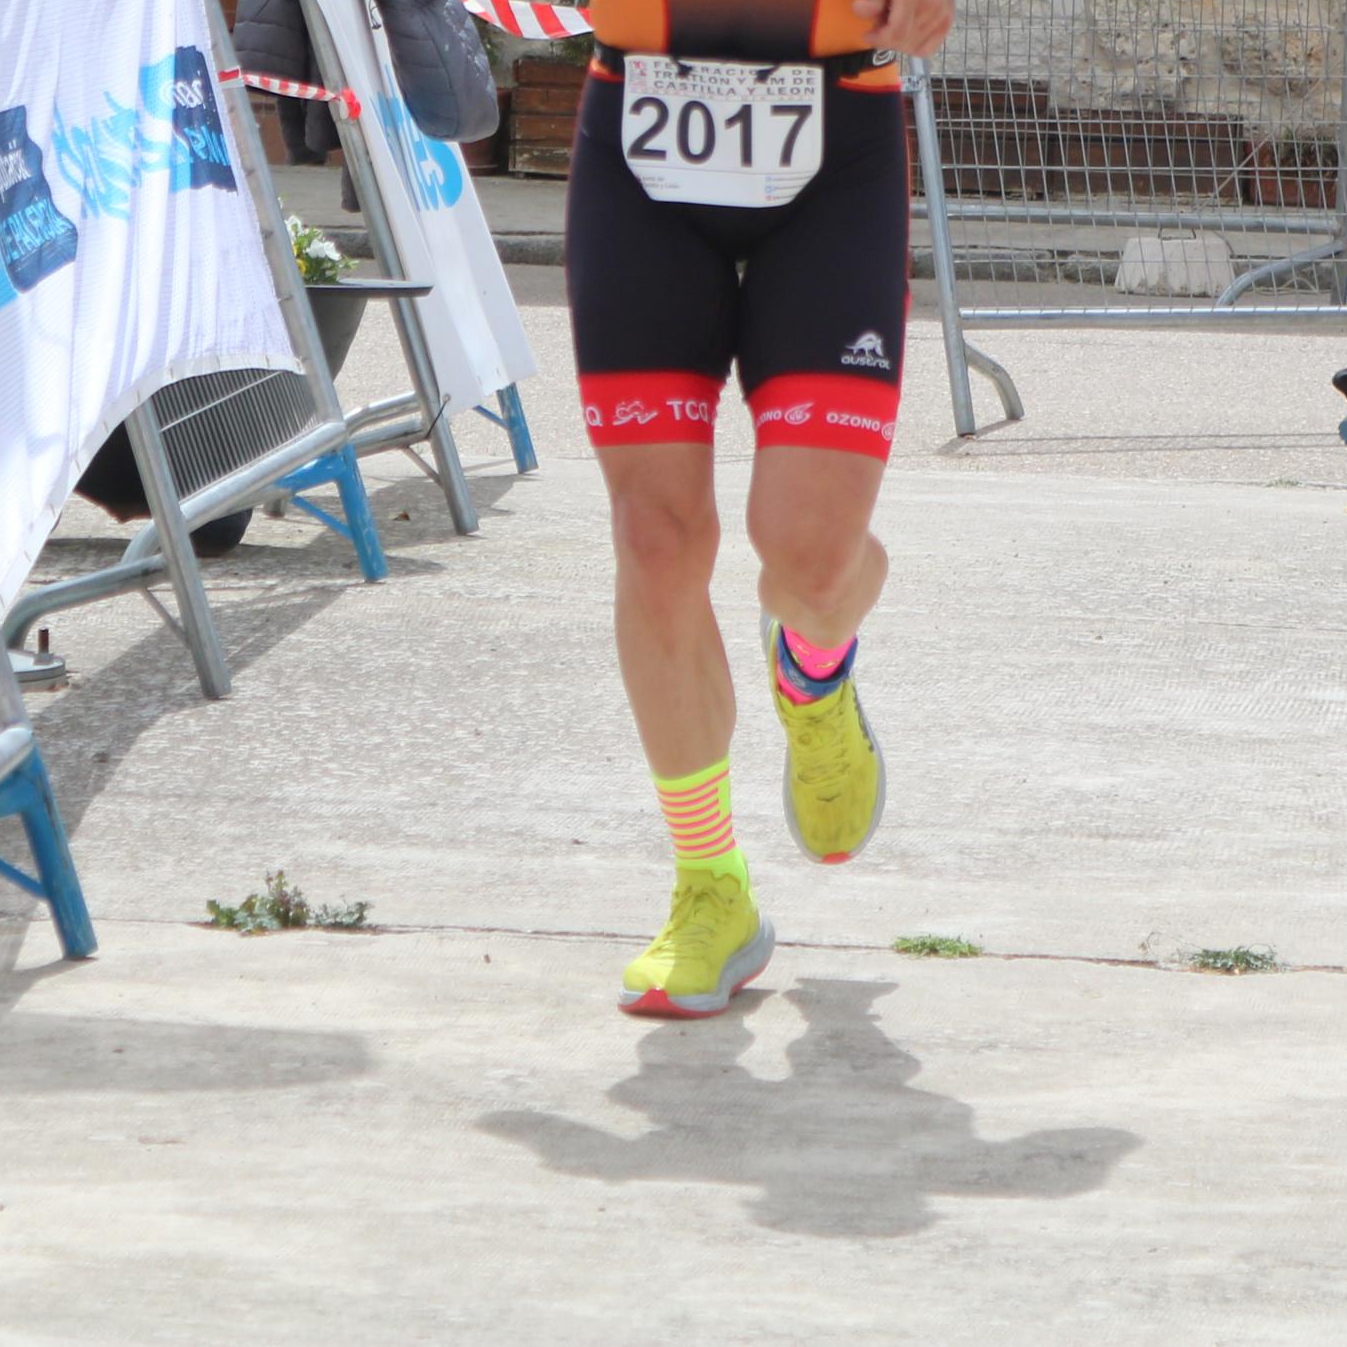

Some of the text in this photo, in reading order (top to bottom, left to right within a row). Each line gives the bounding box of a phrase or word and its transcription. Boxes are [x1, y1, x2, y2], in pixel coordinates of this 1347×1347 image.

[654, 80, 737, 96] CASTILLA
[793, 77, 816, 86] DE
[627, 96, 813, 169] 2017
[665, 399, 710, 425] TCQ
[825, 410, 881, 433] OZONO
